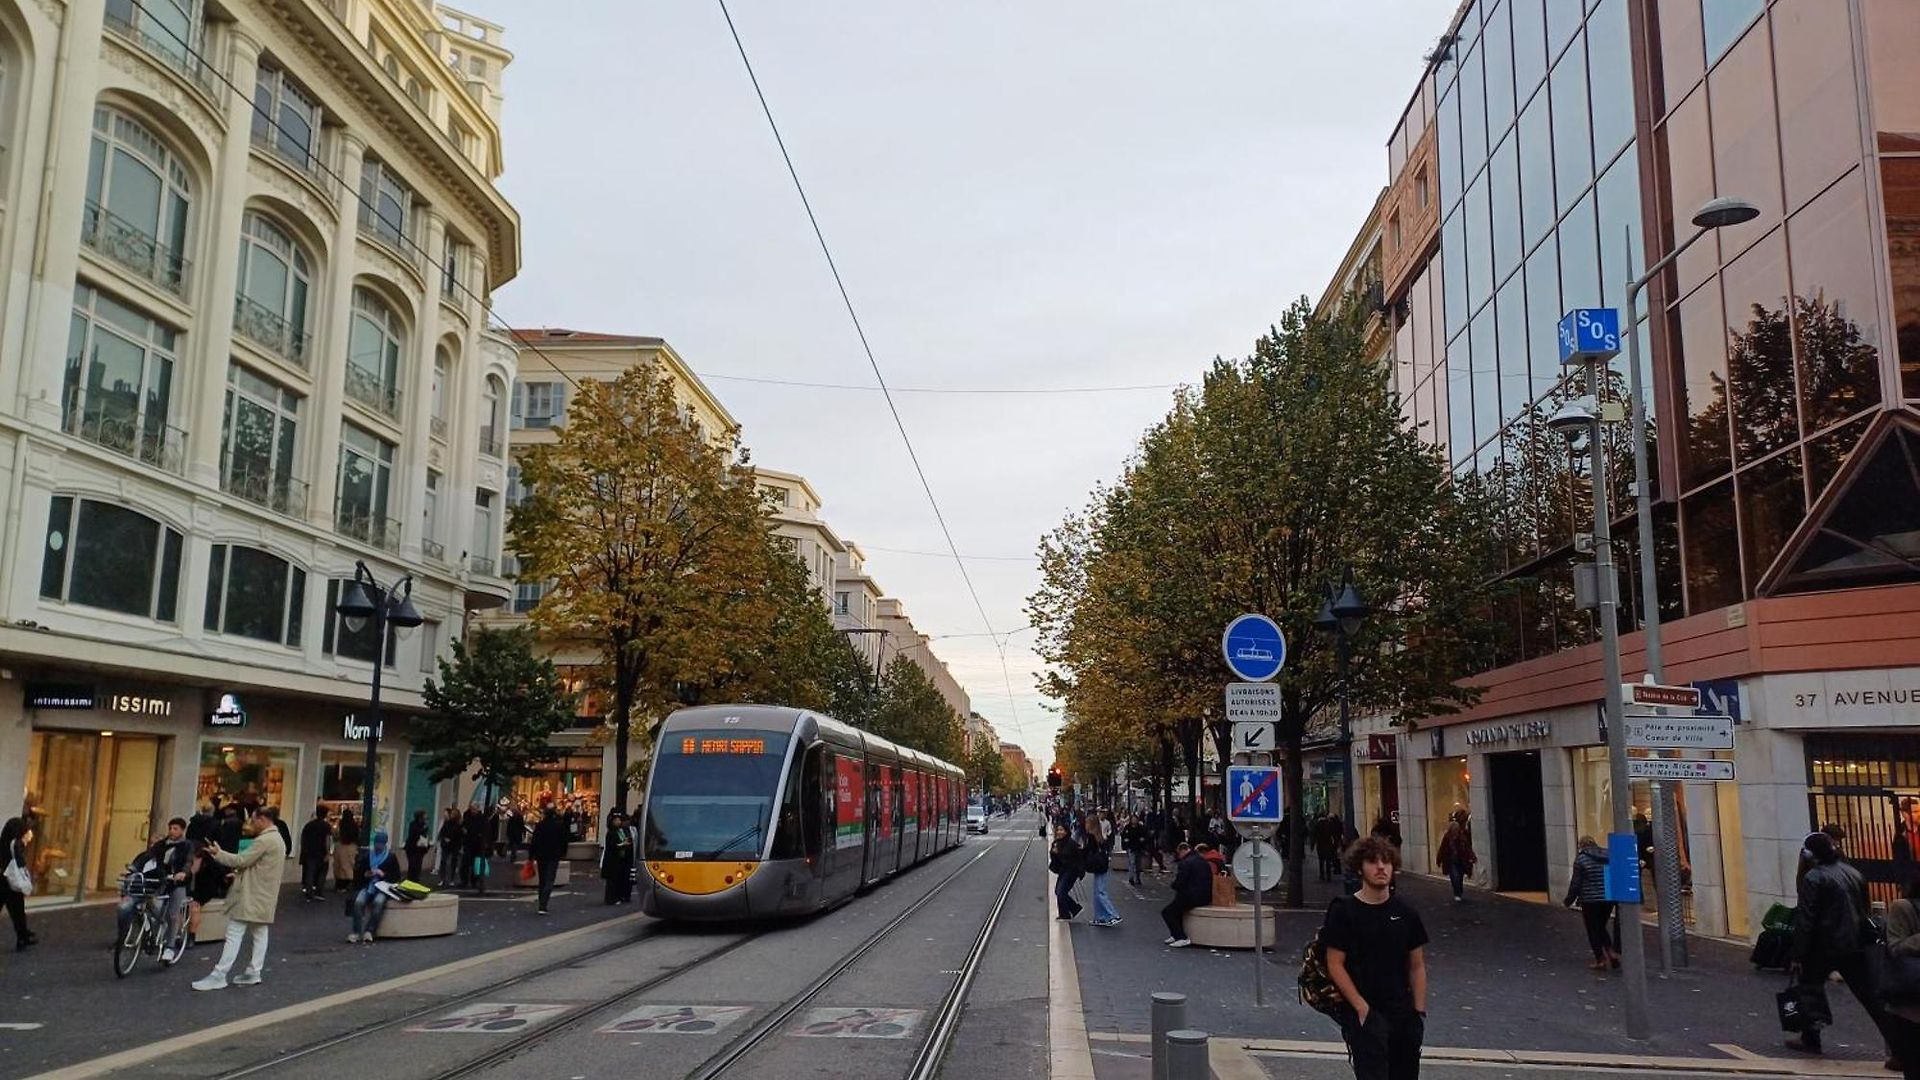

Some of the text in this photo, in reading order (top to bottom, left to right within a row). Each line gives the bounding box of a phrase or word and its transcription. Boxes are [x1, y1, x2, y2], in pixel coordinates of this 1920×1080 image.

[1579, 310, 1617, 350] SOS
[1795, 689, 1920, 707] 37 AVENUE
[1677, 724, 1715, 732] proximité
